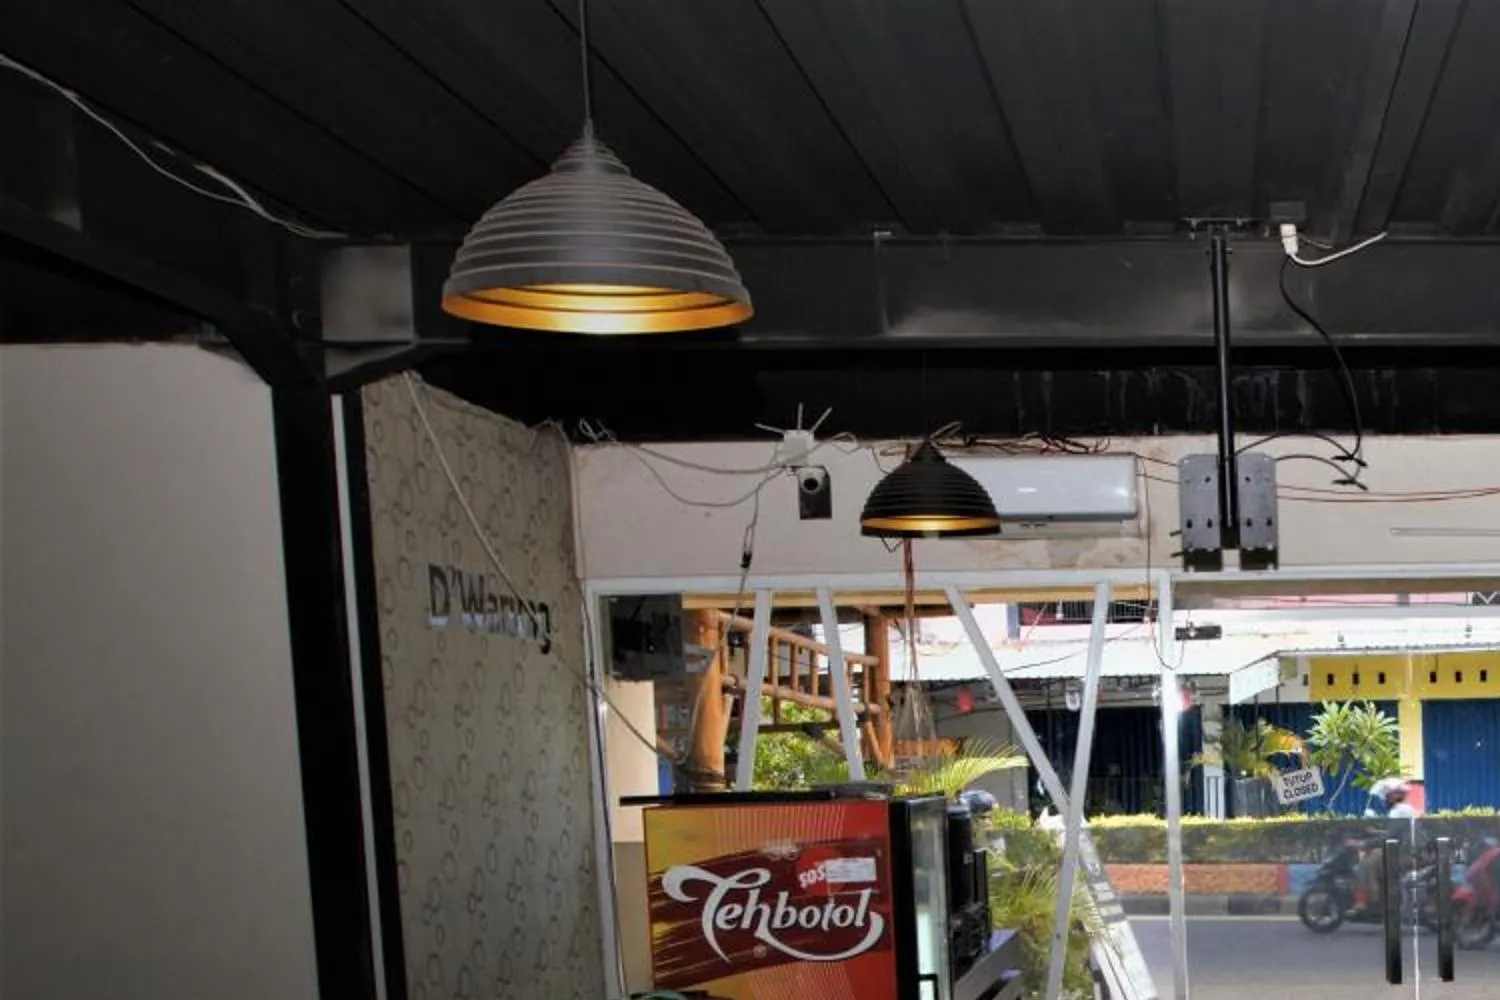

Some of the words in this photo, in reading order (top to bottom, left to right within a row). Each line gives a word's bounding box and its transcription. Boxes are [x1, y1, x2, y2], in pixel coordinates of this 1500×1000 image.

[1283, 771, 1313, 787] TUTUP
[1284, 783, 1319, 799] CLOSED
[661, 864, 886, 966] Tehbotol
